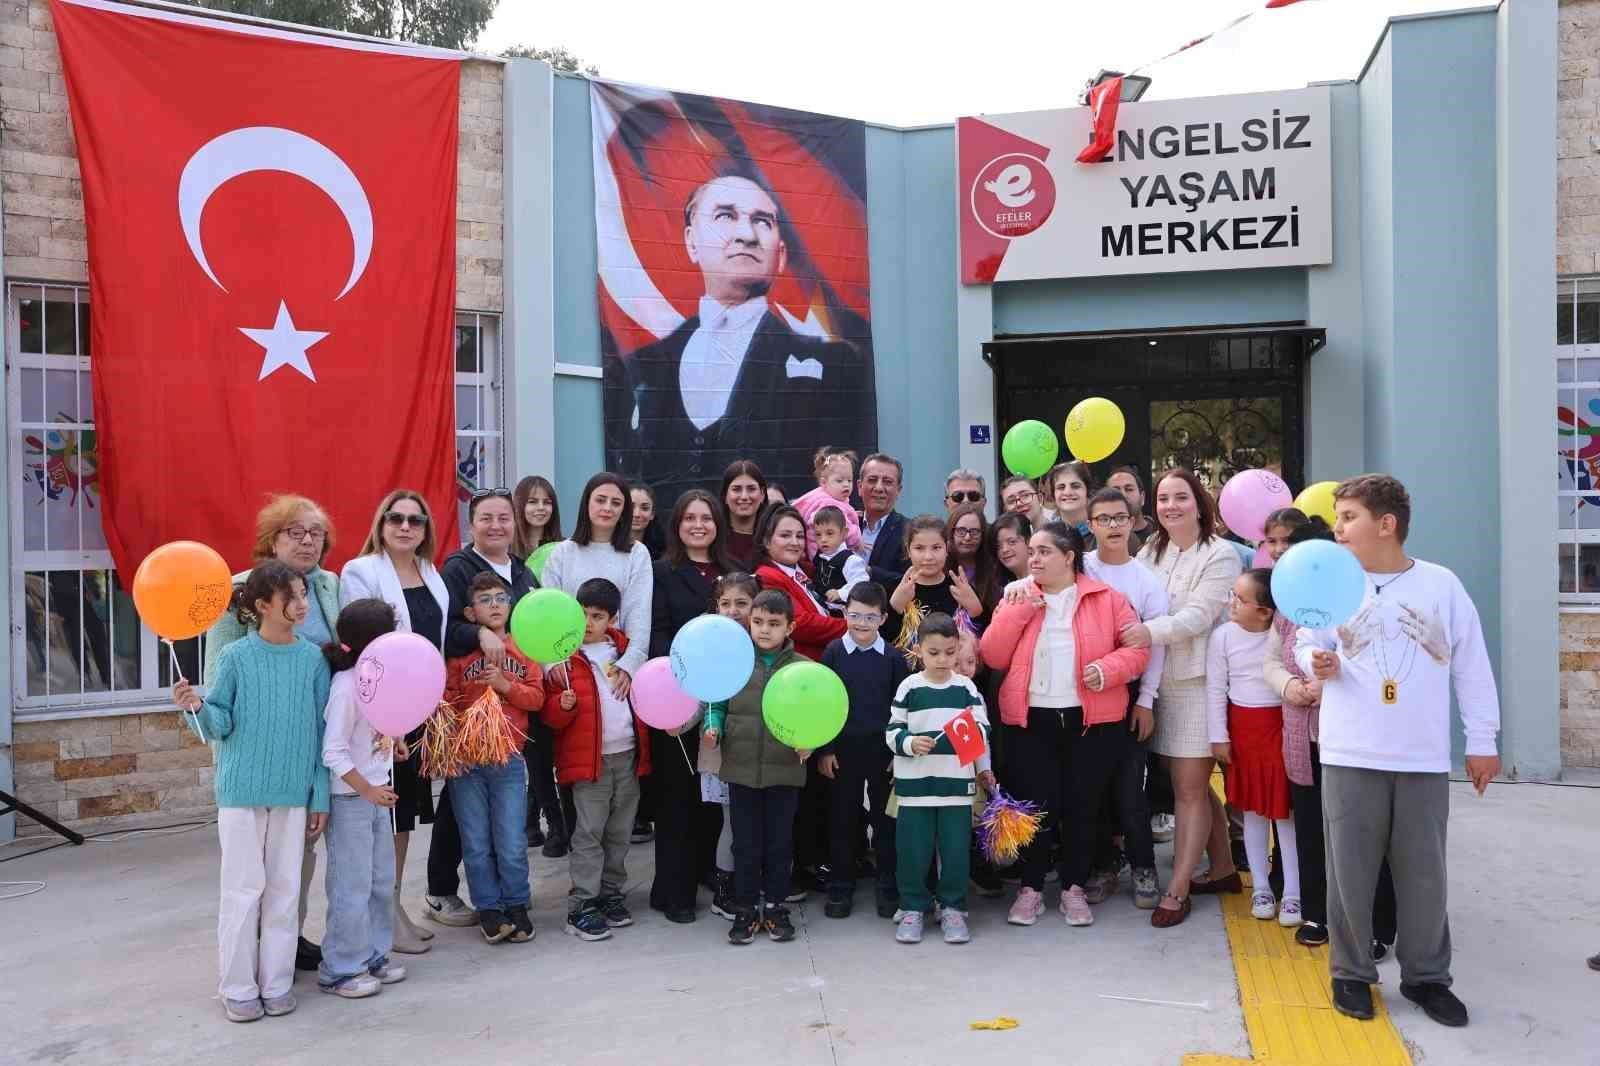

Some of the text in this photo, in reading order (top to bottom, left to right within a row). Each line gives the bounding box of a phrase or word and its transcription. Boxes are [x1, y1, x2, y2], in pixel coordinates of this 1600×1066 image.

[1089, 109, 1311, 162] NGELSİZ
[1120, 167, 1275, 213] YAŞAM
[996, 211, 1032, 222] EFELER
[1101, 206, 1299, 257] MERKEZİ
[1385, 685, 1395, 700] G
